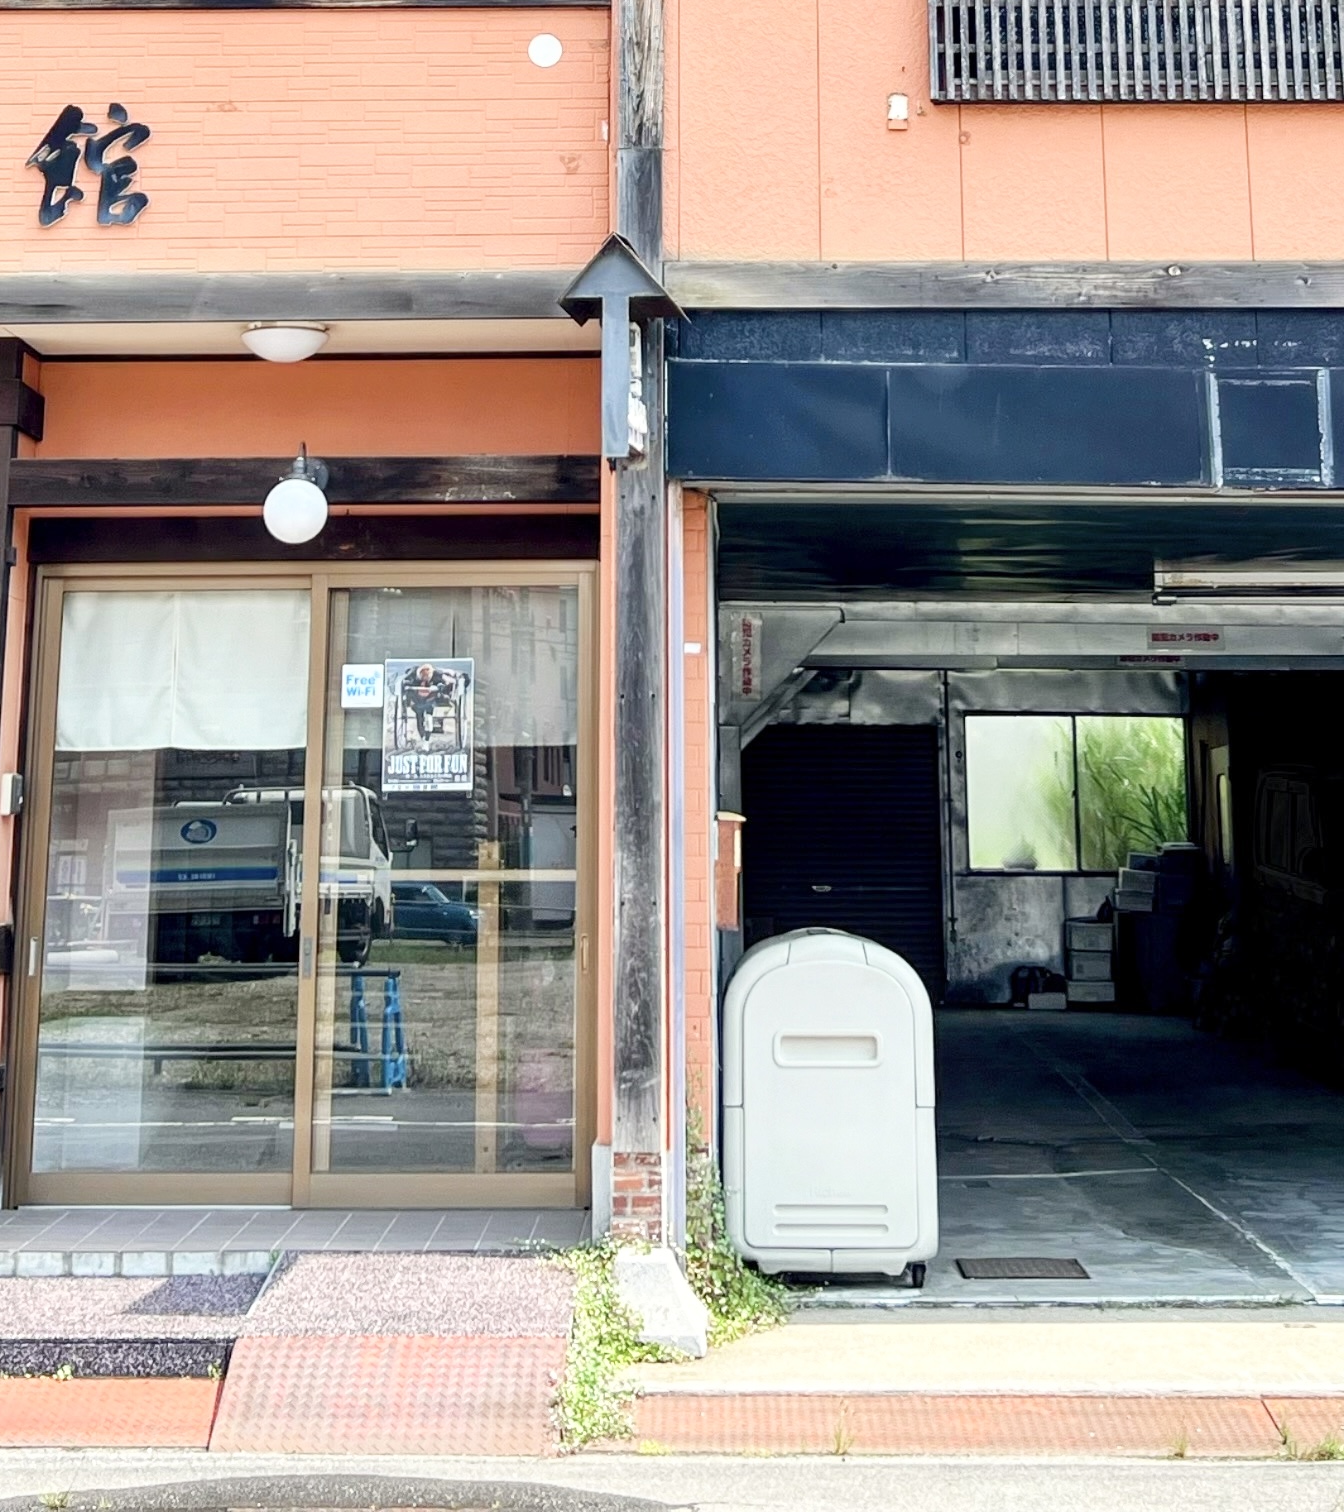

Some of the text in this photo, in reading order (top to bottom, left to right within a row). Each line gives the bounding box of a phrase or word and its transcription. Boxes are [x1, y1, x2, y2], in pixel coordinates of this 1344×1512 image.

[346, 674, 375, 685] Free
[347, 687, 375, 696] Wi-Fi
[388, 755, 467, 774] JUST FOR FUN
